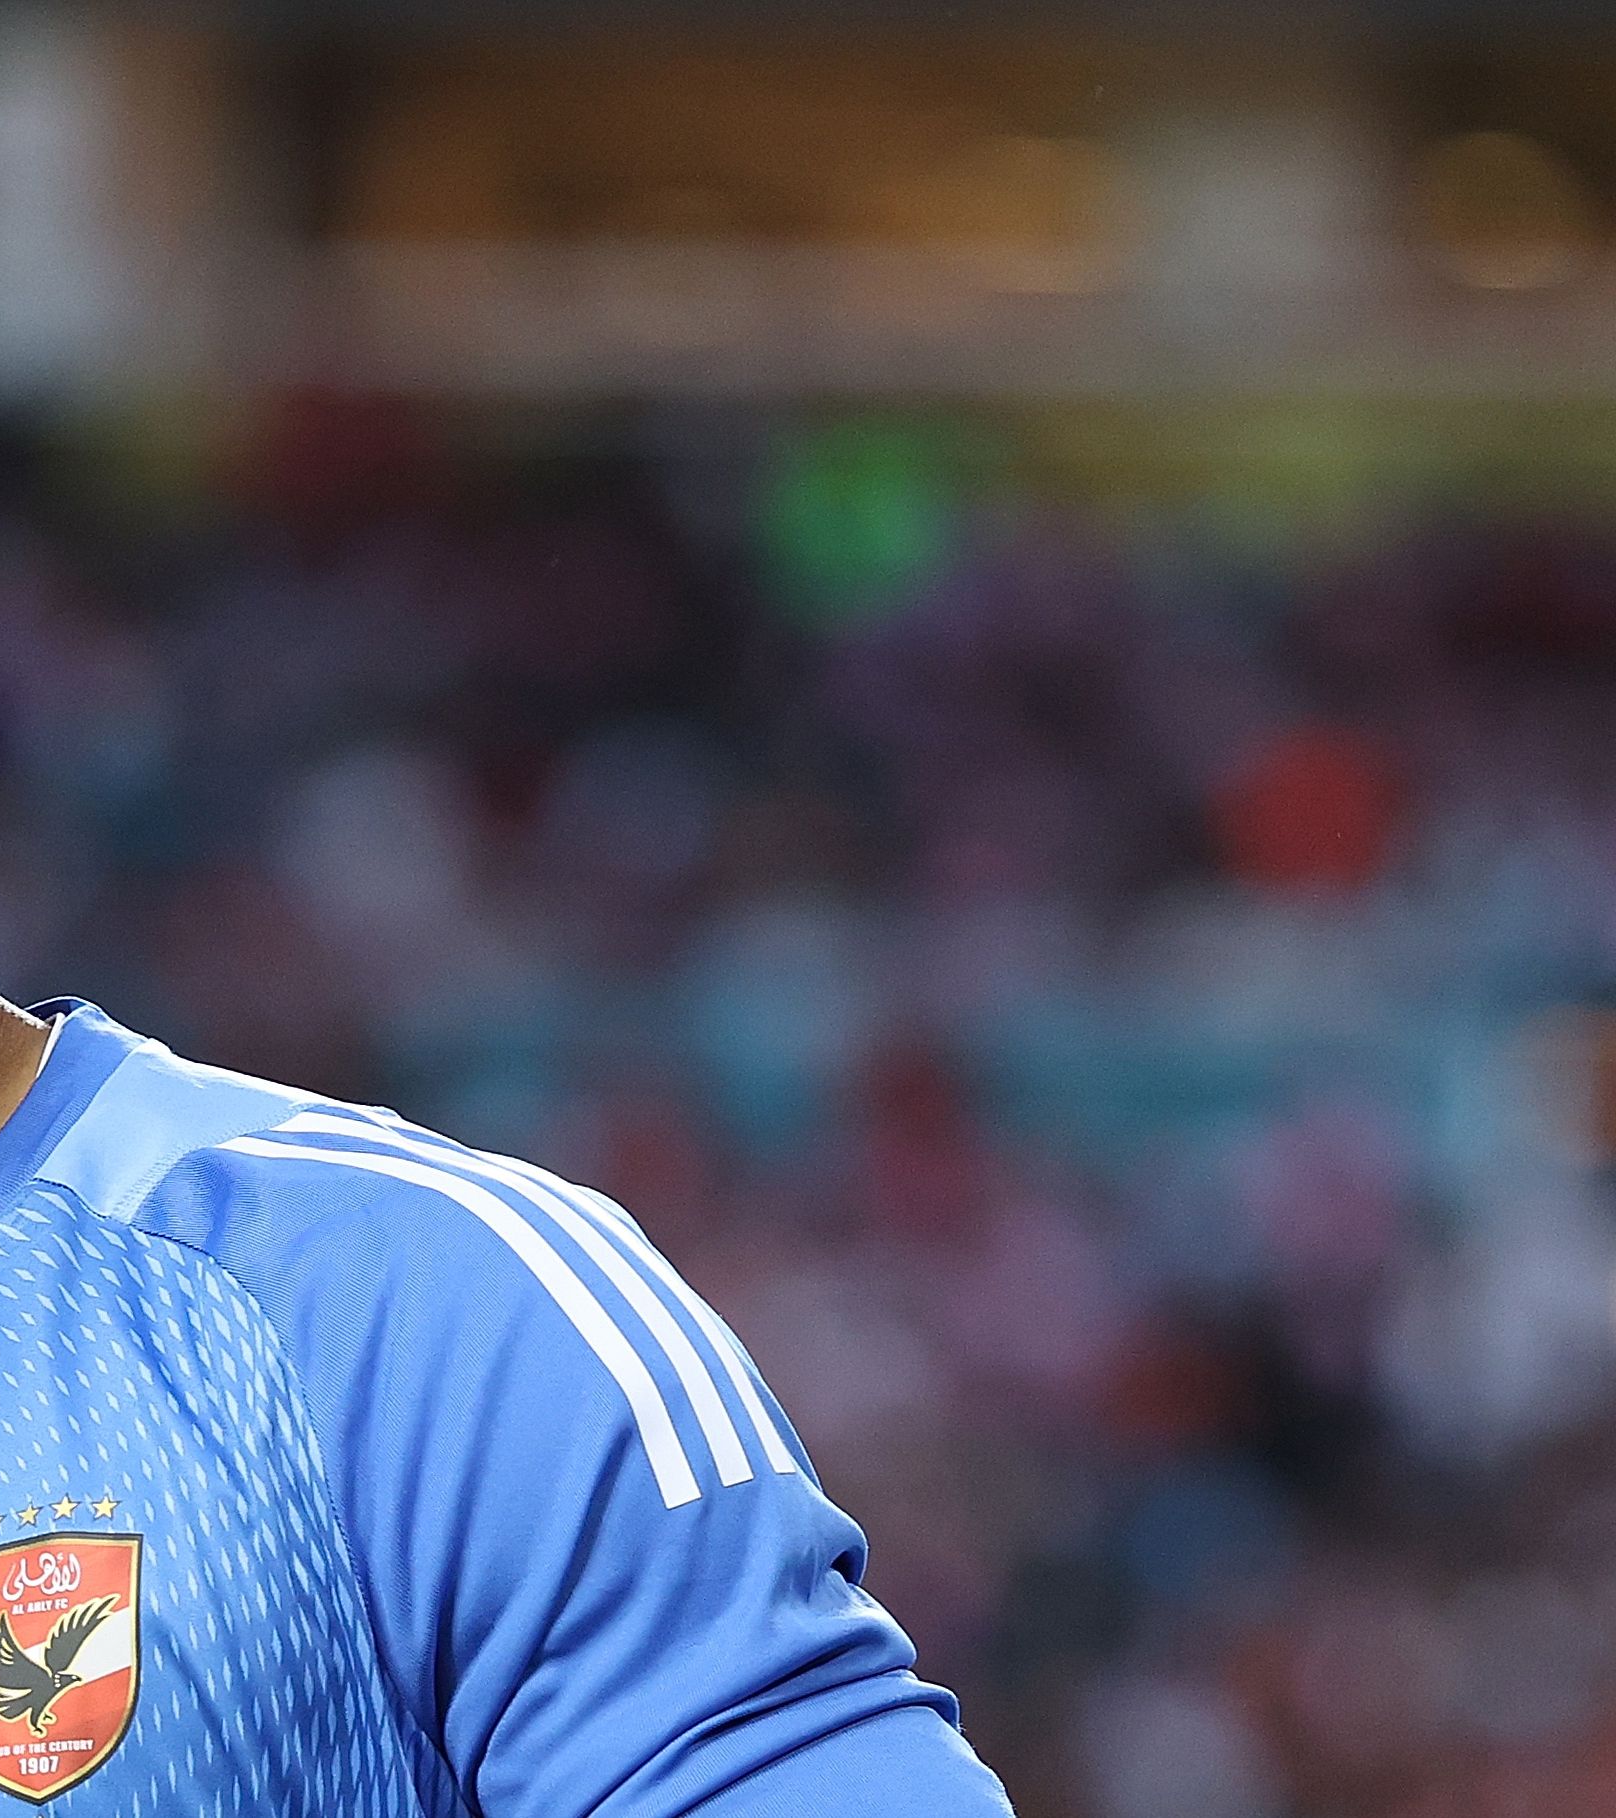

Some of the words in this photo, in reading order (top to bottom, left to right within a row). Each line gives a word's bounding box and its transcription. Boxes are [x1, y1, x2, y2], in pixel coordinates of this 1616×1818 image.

[12, 1603, 24, 1615] AL
[27, 1600, 53, 1613] AHLY
[54, 1598, 69, 1610] FC
[12, 1744, 26, 1755] OF
[28, 1742, 47, 1754] THE
[48, 1739, 93, 1752] CENTURY
[19, 1756, 59, 1775] 1907
